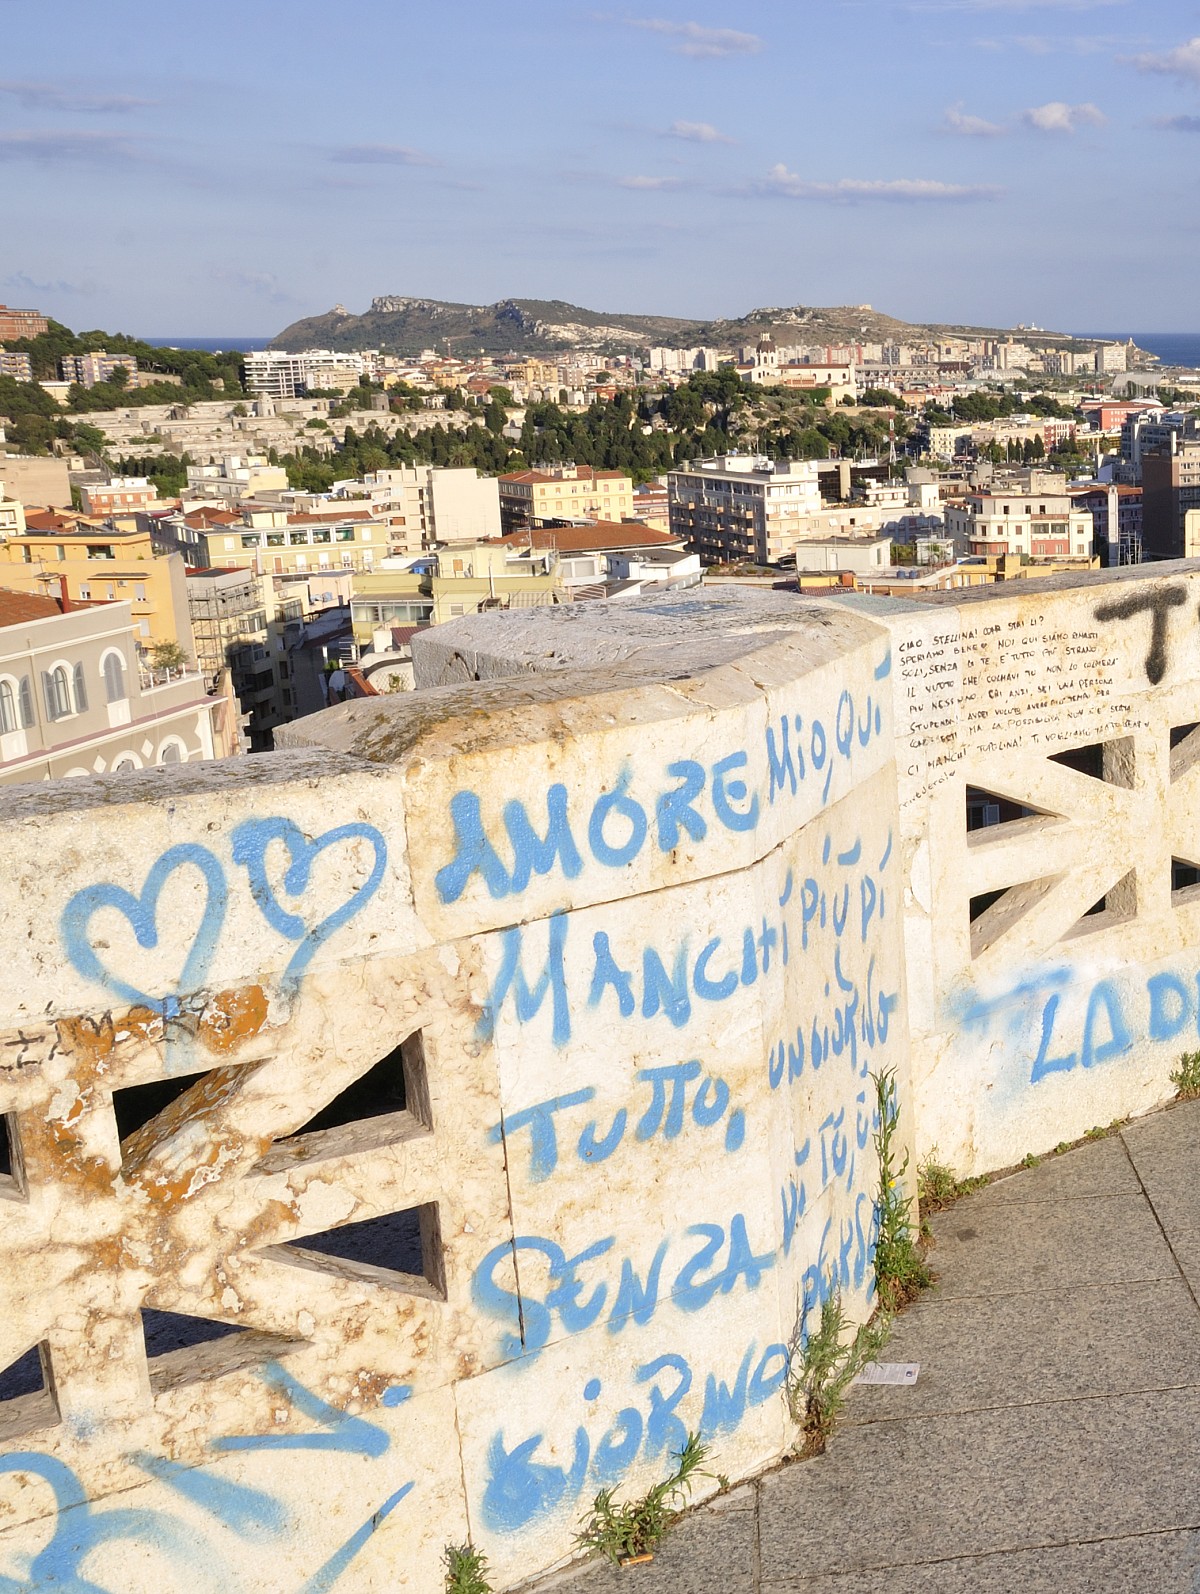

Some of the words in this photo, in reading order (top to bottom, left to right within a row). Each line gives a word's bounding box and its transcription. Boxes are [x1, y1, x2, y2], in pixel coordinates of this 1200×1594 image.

[899, 640, 922, 652] CIAO
[933, 629, 978, 645] STELLINA!
[1008, 621, 1024, 630] STAI
[900, 650, 944, 666] SPERIAMO
[998, 639, 1014, 649] NOI
[1022, 637, 1037, 645] QUI
[1042, 632, 1068, 642] SIAMO
[929, 662, 957, 675] SENZA
[981, 657, 990, 665] TE
[1011, 650, 1035, 661] TUTTO
[907, 687, 916, 698] IL
[962, 676, 978, 686] CHE
[986, 673, 1019, 683] COLMAVI
[1046, 665, 1062, 673] NON
[1069, 663, 1077, 671] LO
[1079, 678, 1113, 689] PERSONA
[967, 711, 988, 720] AVREI
[969, 725, 983, 735] MA
[1067, 709, 1083, 719] NON
[907, 764, 918, 776] CI
[437, 750, 759, 905] AMORE
[1030, 978, 1133, 1085] LA
[474, 1212, 777, 1372] SENZA
